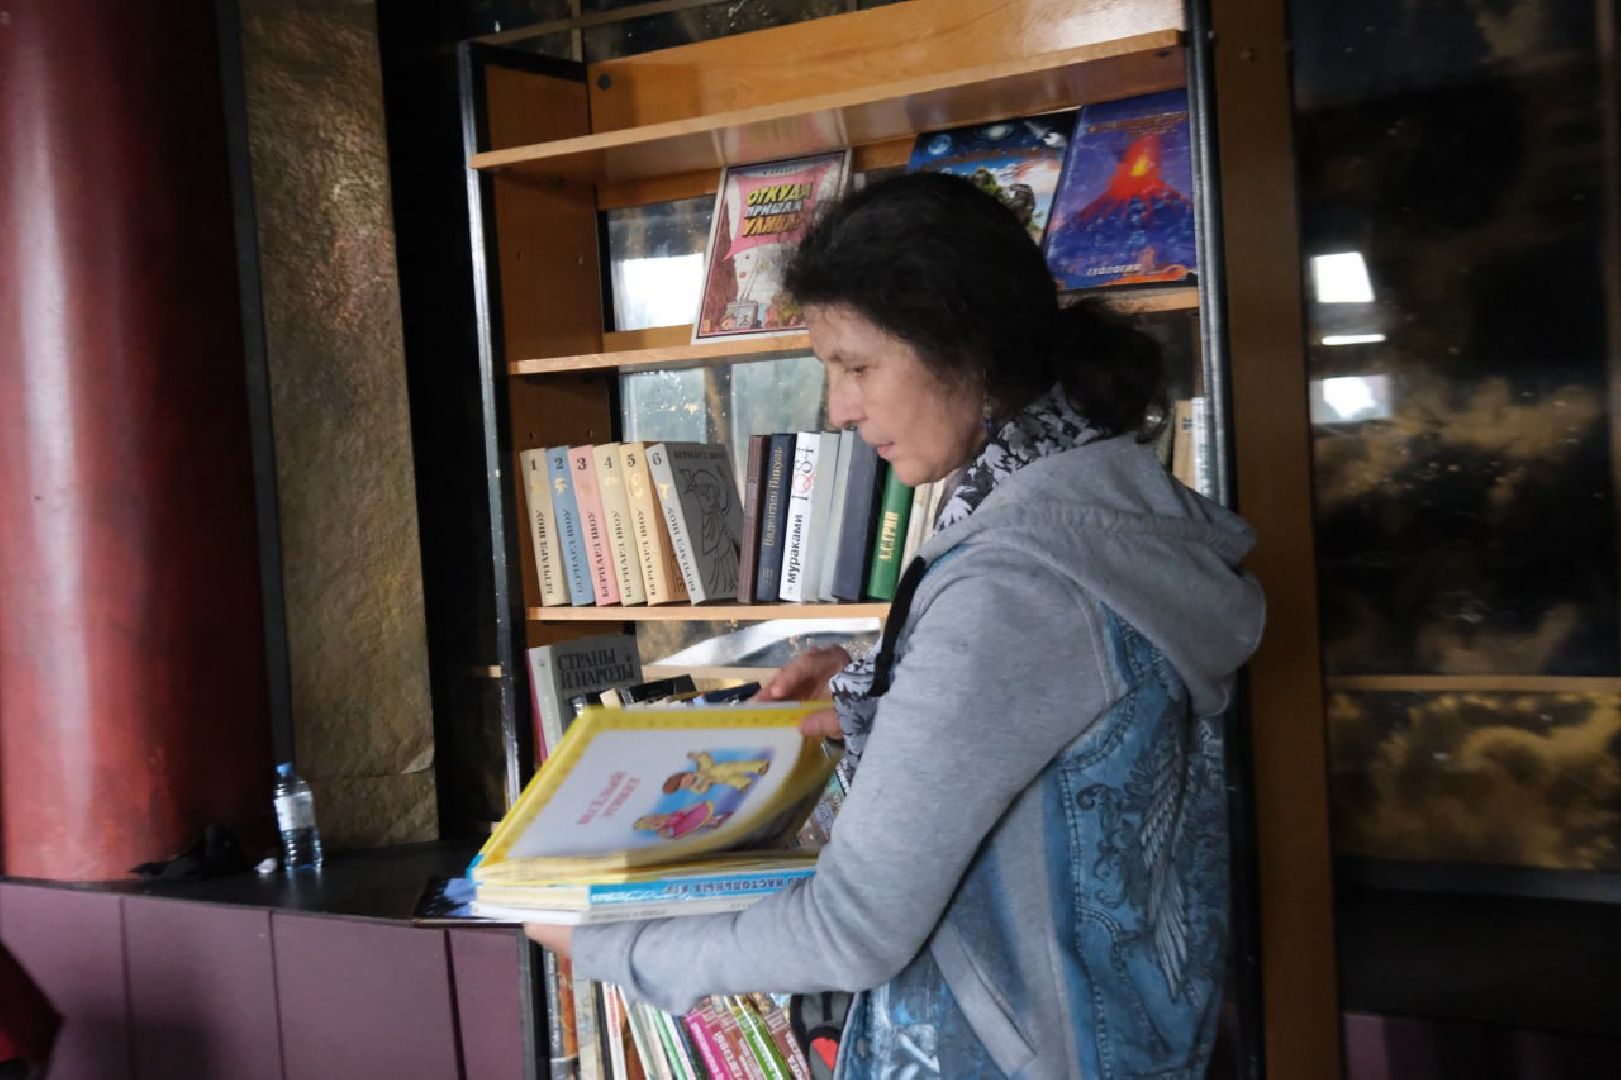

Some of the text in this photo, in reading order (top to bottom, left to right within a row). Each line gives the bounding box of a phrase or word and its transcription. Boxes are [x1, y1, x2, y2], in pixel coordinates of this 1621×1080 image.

[747, 182, 813, 206] ОТКУДА
[531, 459, 536, 470] 1
[554, 457, 564, 470] 2
[577, 457, 587, 470] 3
[604, 456, 613, 469] 4
[627, 453, 636, 468] 5
[652, 452, 663, 466] 6
[791, 447, 816, 501] 1Q84
[762, 447, 783, 546] Валентин Пикуль
[787, 514, 803, 584] мураками
[558, 648, 615, 671] СТРАНЫ
[561, 664, 634, 688] И НАРОДЫ
[695, 878, 784, 893] НАСТОЛЬНЫХ
